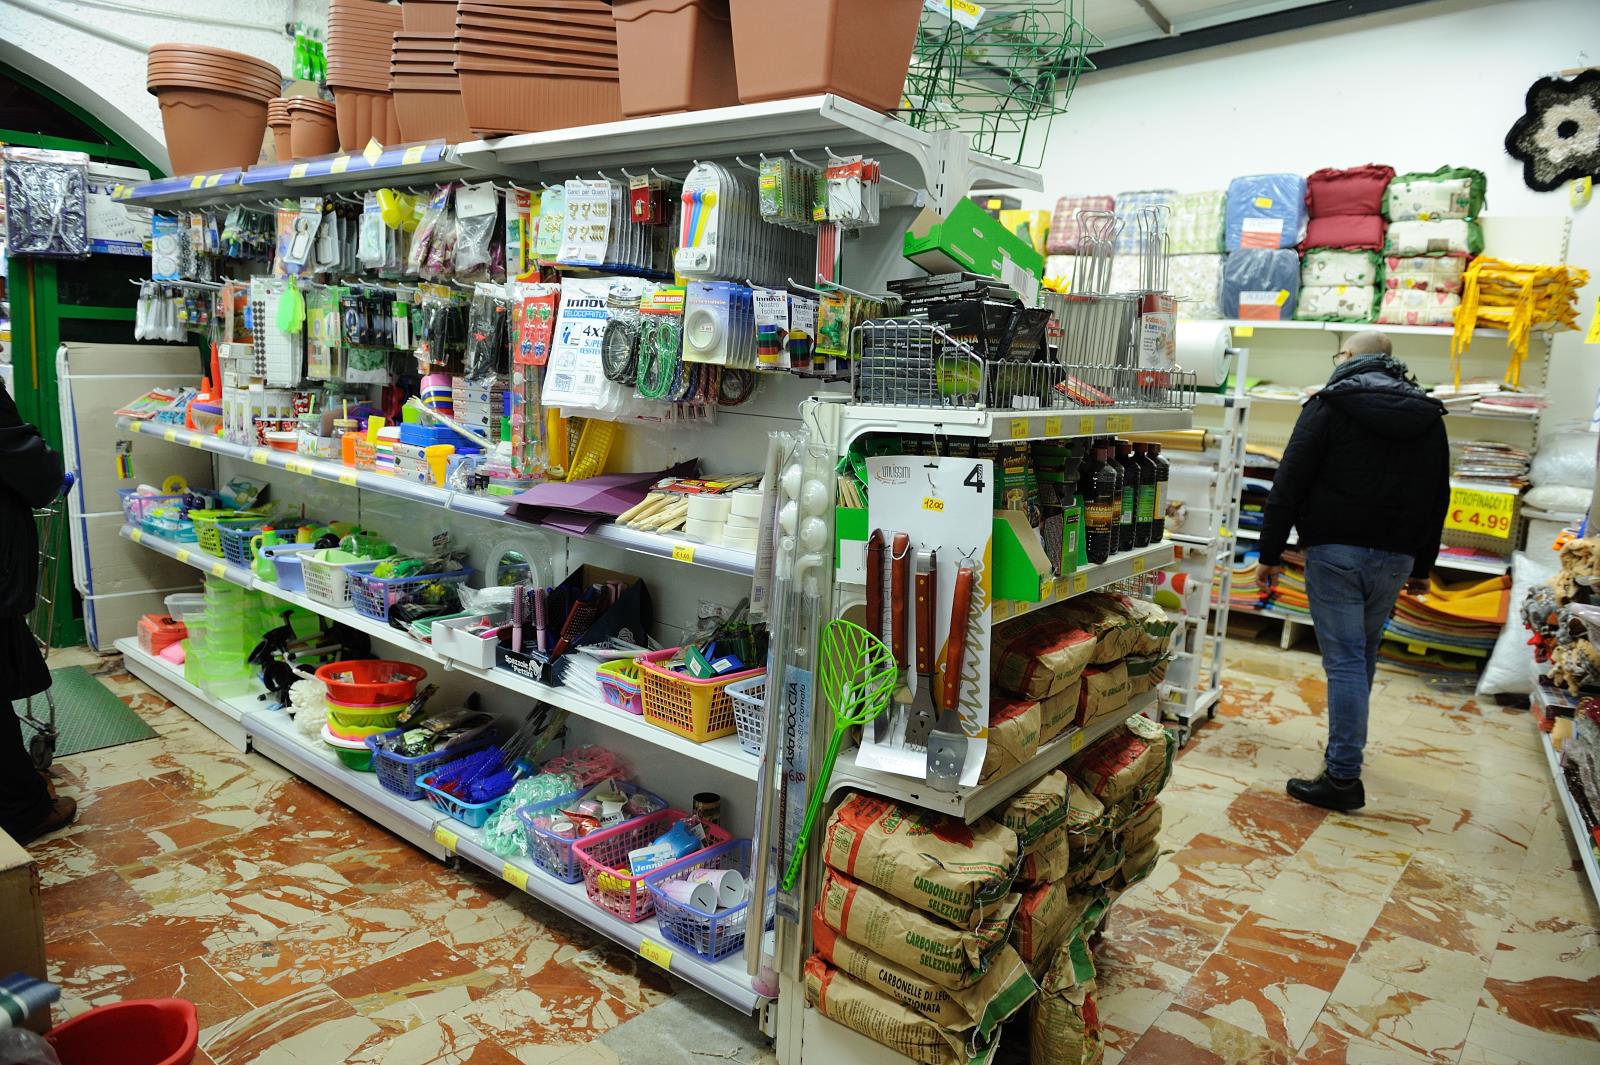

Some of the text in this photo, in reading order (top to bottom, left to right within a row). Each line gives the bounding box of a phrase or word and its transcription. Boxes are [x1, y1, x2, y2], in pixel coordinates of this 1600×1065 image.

[1452, 509, 1509, 531] € 4.99
[784, 682, 799, 767] Asta DOCCIA
[913, 875, 962, 905] CARBONELLE
[905, 930, 954, 959] CARBONELLE
[878, 968, 922, 999] CARBONELLE
[924, 990, 933, 1001] DI
